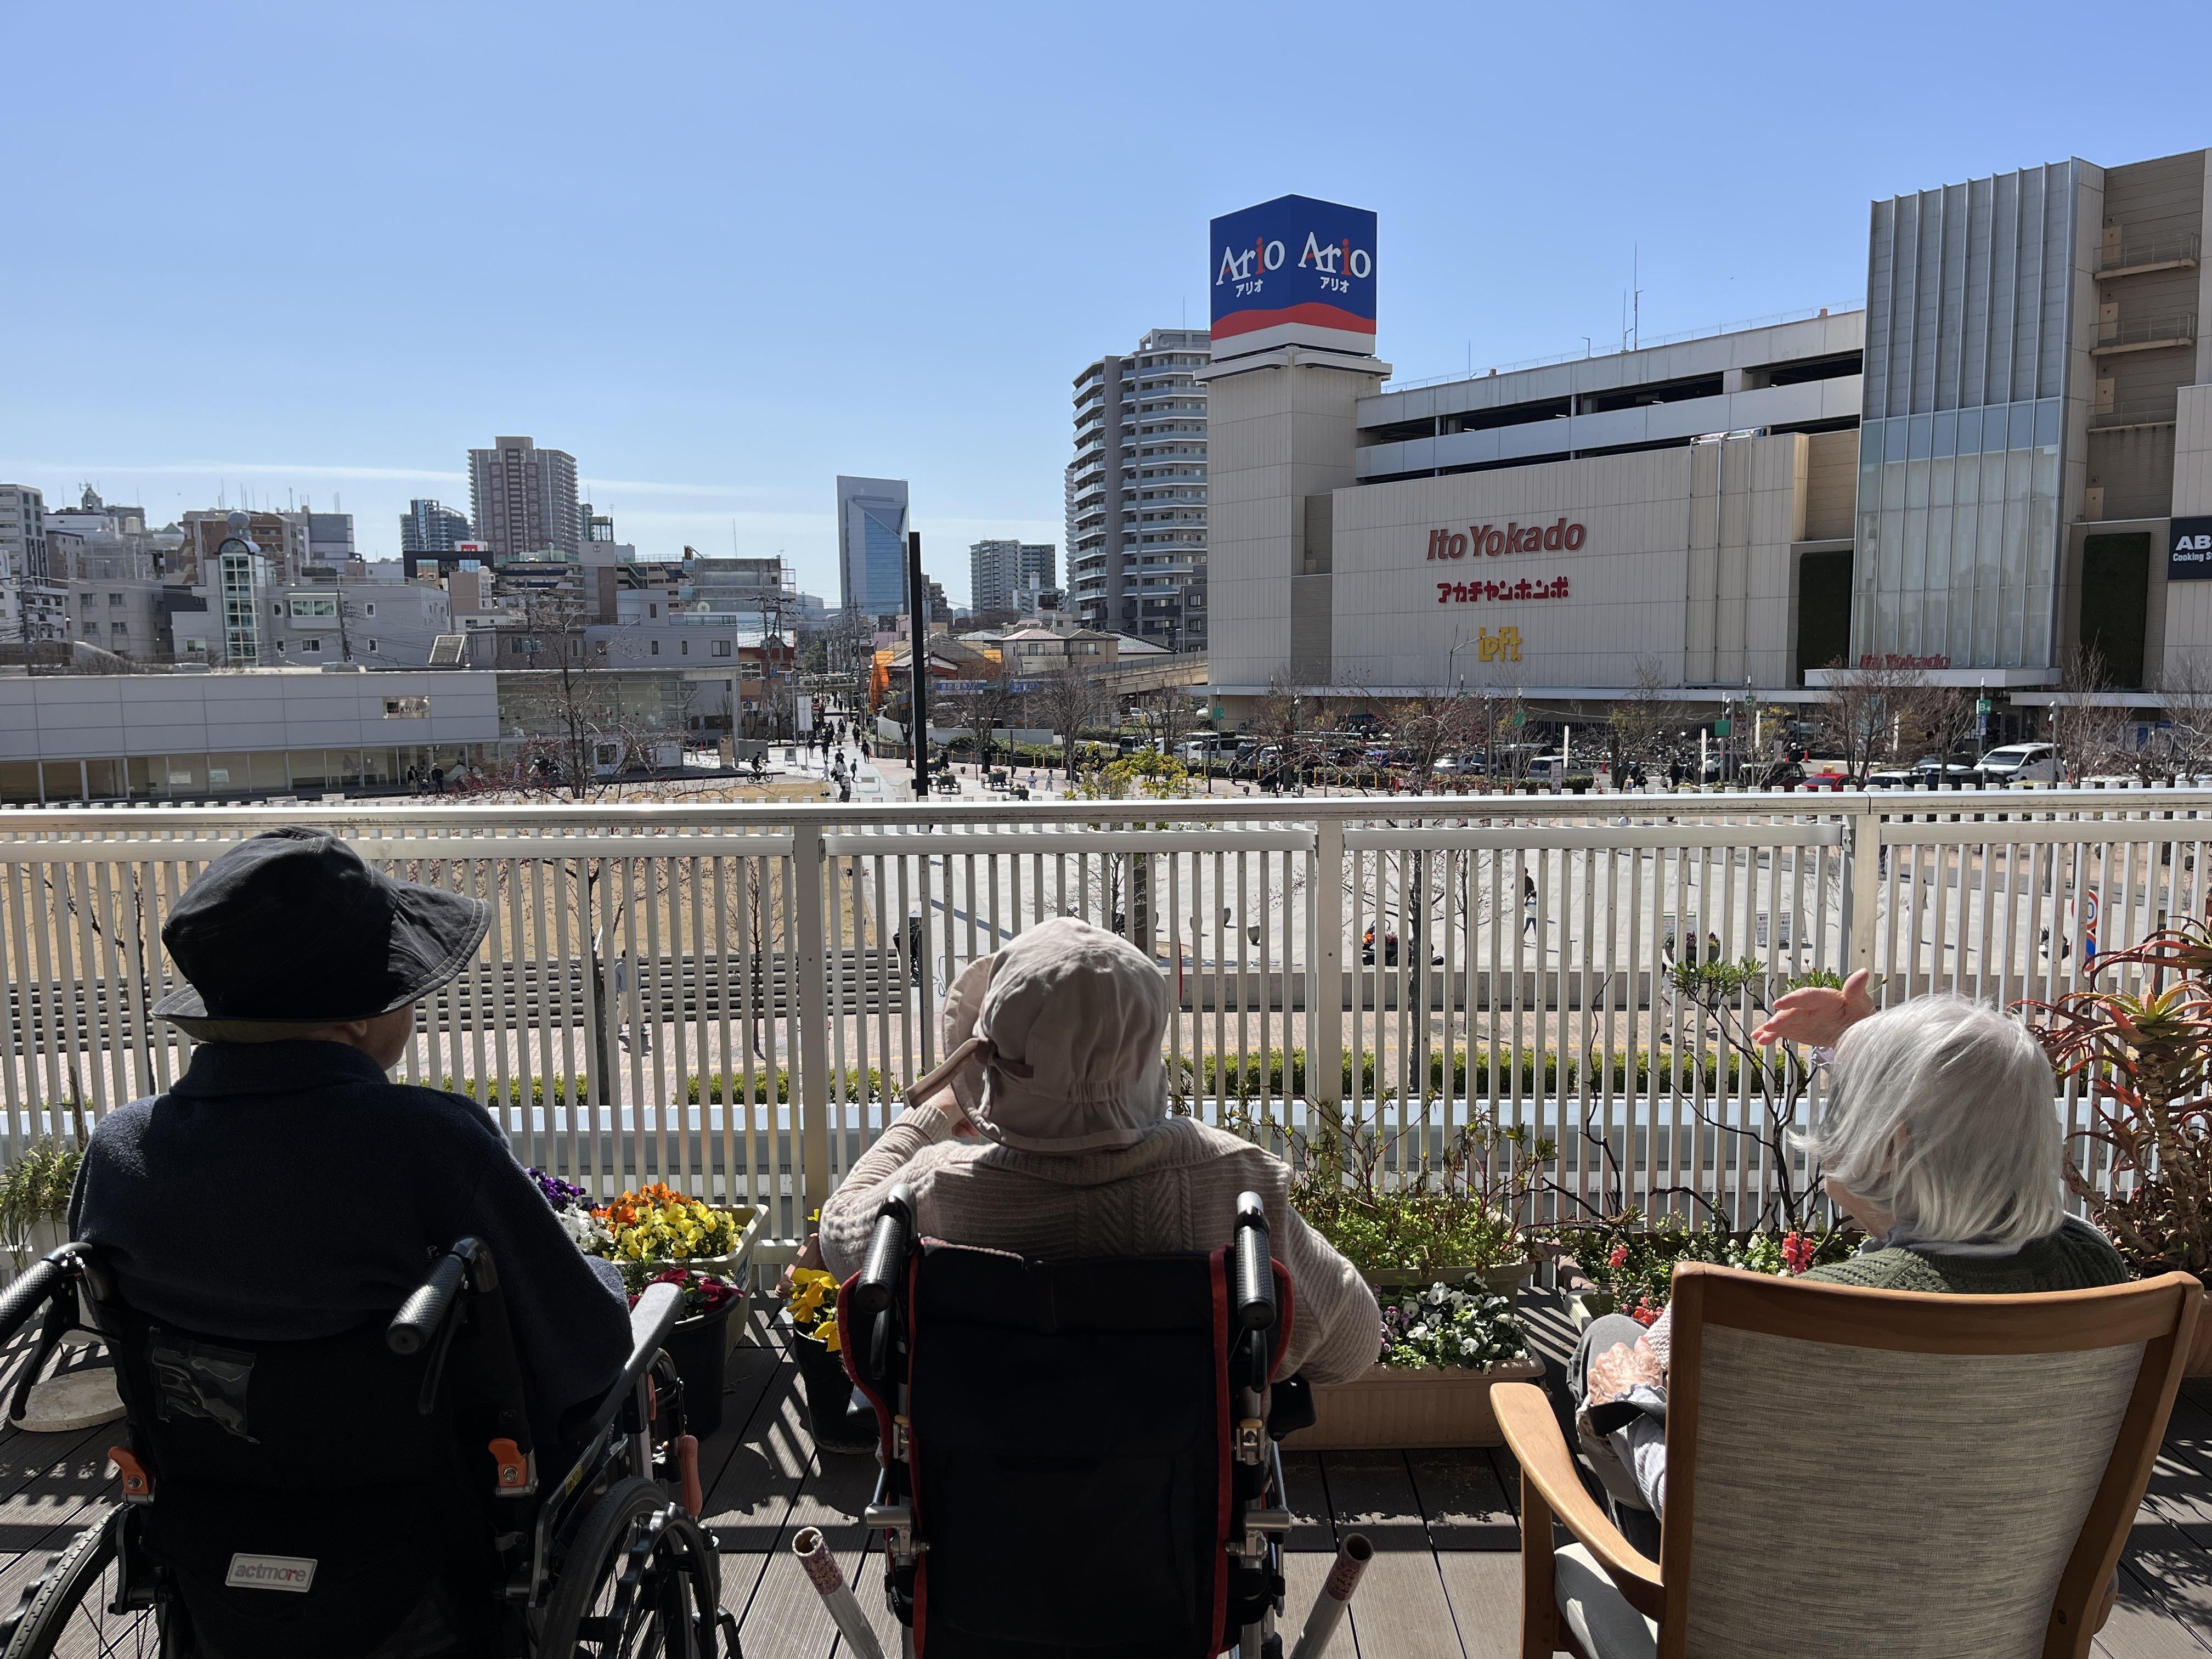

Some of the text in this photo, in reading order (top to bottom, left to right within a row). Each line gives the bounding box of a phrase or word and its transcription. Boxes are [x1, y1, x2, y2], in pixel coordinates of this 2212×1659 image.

[1216, 236, 1285, 286] Ario
[1297, 232, 1371, 279] Ario
[1235, 279, 1263, 298] アリオ
[1320, 276, 1350, 294] アリオ
[2175, 535, 2212, 551] AB
[2172, 552, 2204, 562] Cooking
[1436, 576, 1569, 603] アカチャンホンポ
[1479, 626, 1523, 662] Loft
[1979, 703, 1985, 712] B
[234, 1562, 306, 1583] actmore
